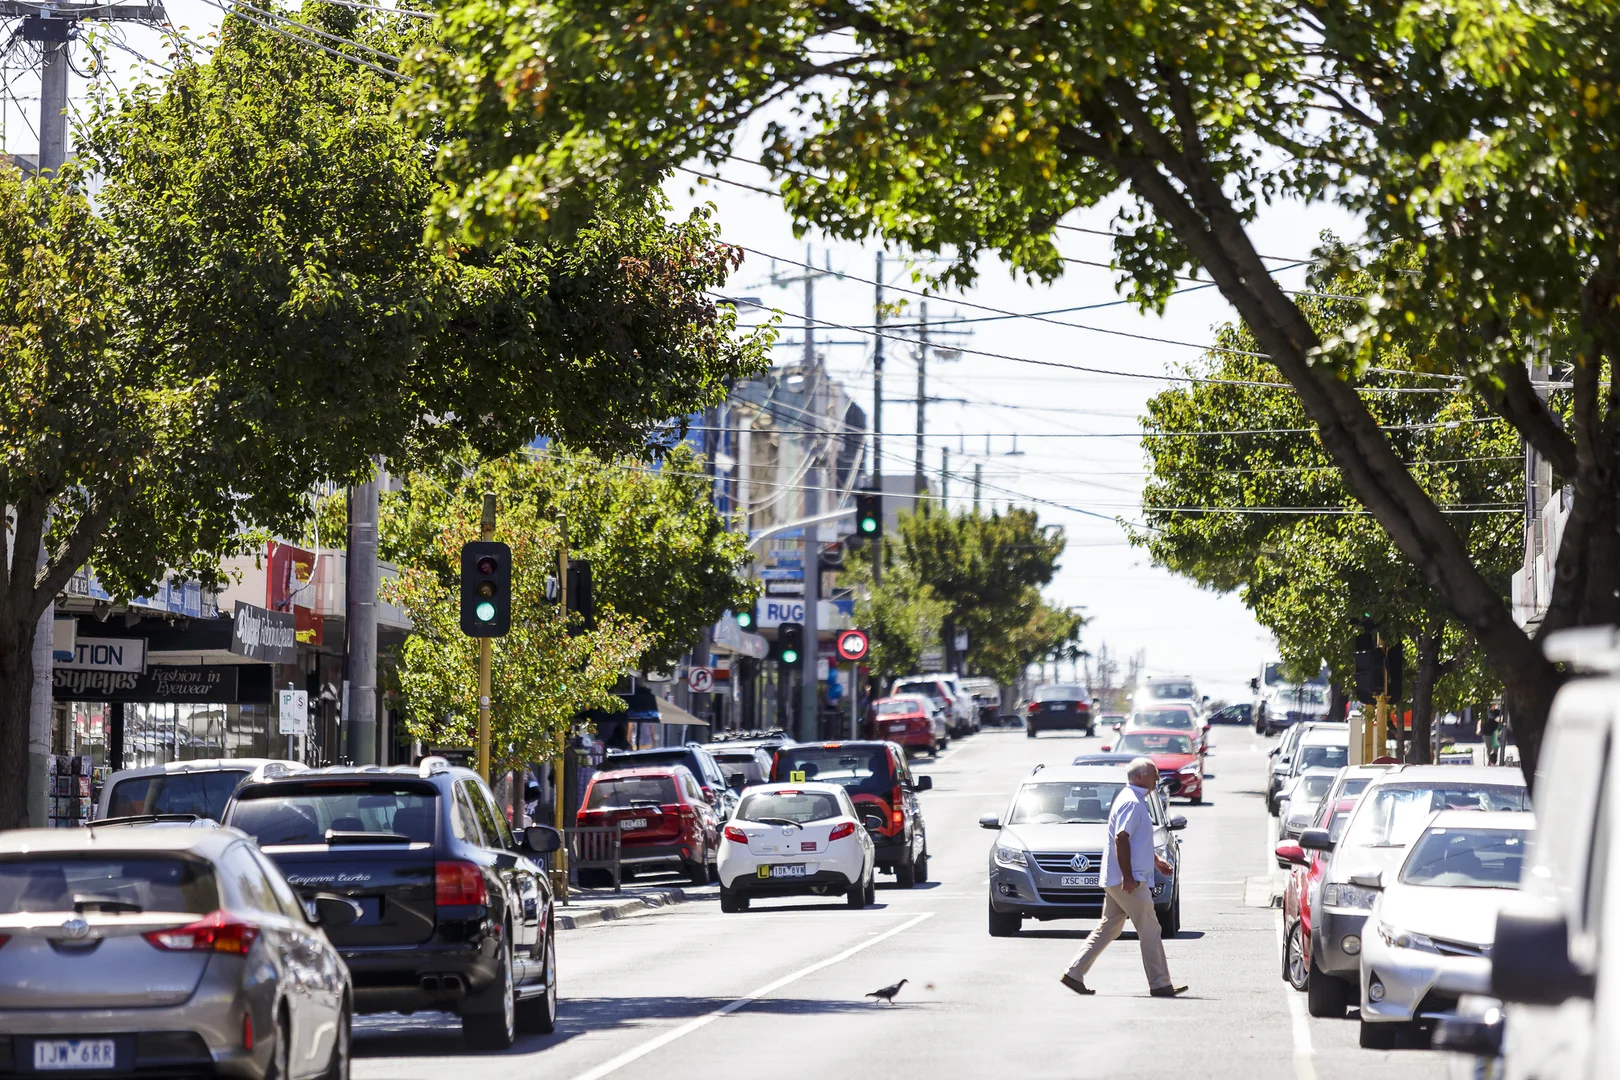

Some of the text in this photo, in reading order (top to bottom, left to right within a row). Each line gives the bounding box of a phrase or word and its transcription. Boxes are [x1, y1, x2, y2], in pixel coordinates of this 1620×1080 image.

[843, 636, 864, 652] 40
[151, 668, 221, 683] Fashion in
[156, 681, 213, 696] Eyewear
[287, 872, 372, 886] Cayenne turbo
